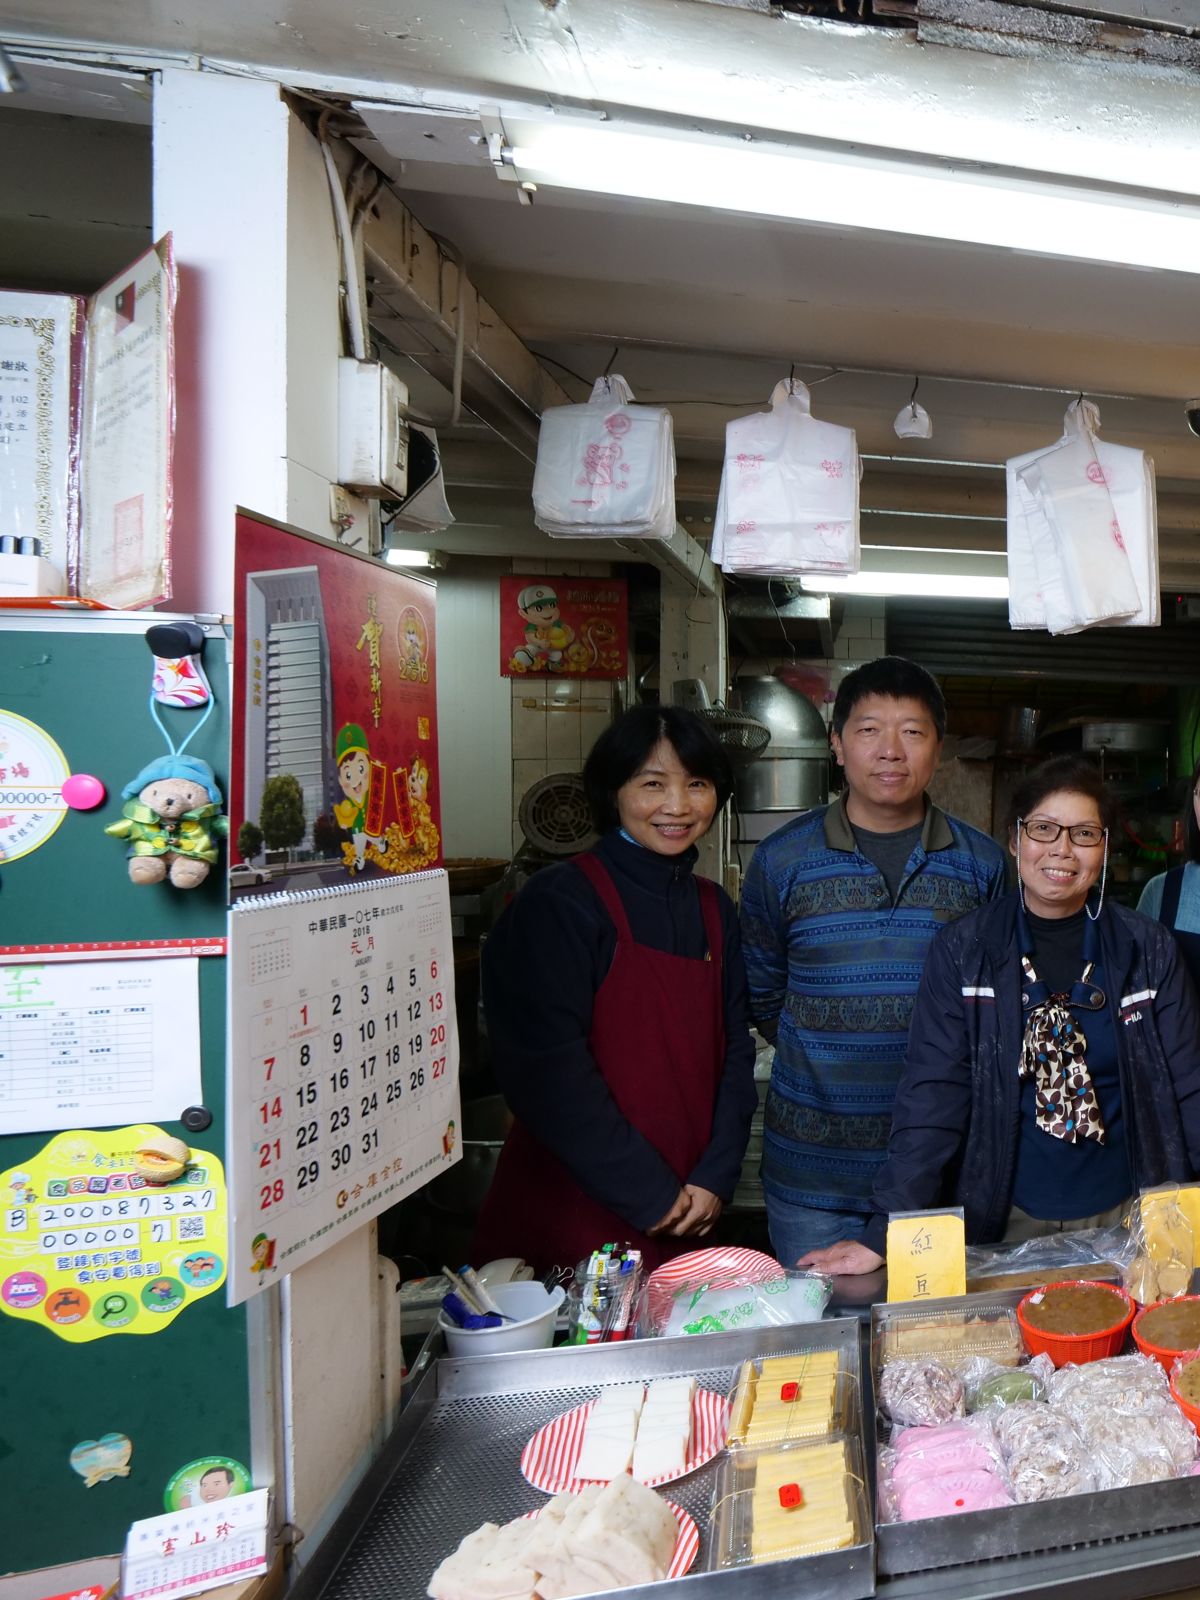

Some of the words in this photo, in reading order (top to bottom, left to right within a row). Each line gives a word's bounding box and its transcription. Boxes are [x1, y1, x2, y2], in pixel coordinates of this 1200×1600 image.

[351, 936, 375, 955] 元月
[353, 925, 371, 938] 2018
[300, 1005, 307, 1026] 1
[332, 994, 341, 1016] 2
[361, 985, 369, 1005] 3
[387, 976, 394, 995] 4
[409, 968, 416, 987] 5
[431, 961, 437, 979] 6
[264, 1057, 276, 1081] 7
[300, 1044, 311, 1066] 8
[333, 1033, 342, 1054] 9
[359, 1020, 375, 1042] 10
[385, 1010, 398, 1031] 11
[408, 1001, 421, 1021] 12
[429, 992, 443, 1012] 13
[260, 1096, 282, 1124] 14
[296, 1081, 317, 1108] 15
[331, 1068, 349, 1093] 16
[361, 1056, 376, 1079] 17
[386, 1045, 400, 1067] 18
[409, 1034, 422, 1055] 19
[430, 1025, 445, 1046] 20
[259, 1138, 281, 1168] 21
[296, 1122, 318, 1150] 22
[331, 1106, 350, 1133] 23
[361, 1092, 378, 1118] 24
[386, 1079, 402, 1104] 25
[410, 1068, 424, 1091] 26
[433, 1057, 446, 1079] 27
[261, 1179, 284, 1210] 28
[297, 1161, 319, 1190] 29
[331, 1144, 351, 1170] 30
[362, 1129, 378, 1154] 31
[350, 1157, 403, 1200] 合庫金控
[57, 1249, 141, 1270] 登錄有字號
[911, 1227, 933, 1297] 紅豆
